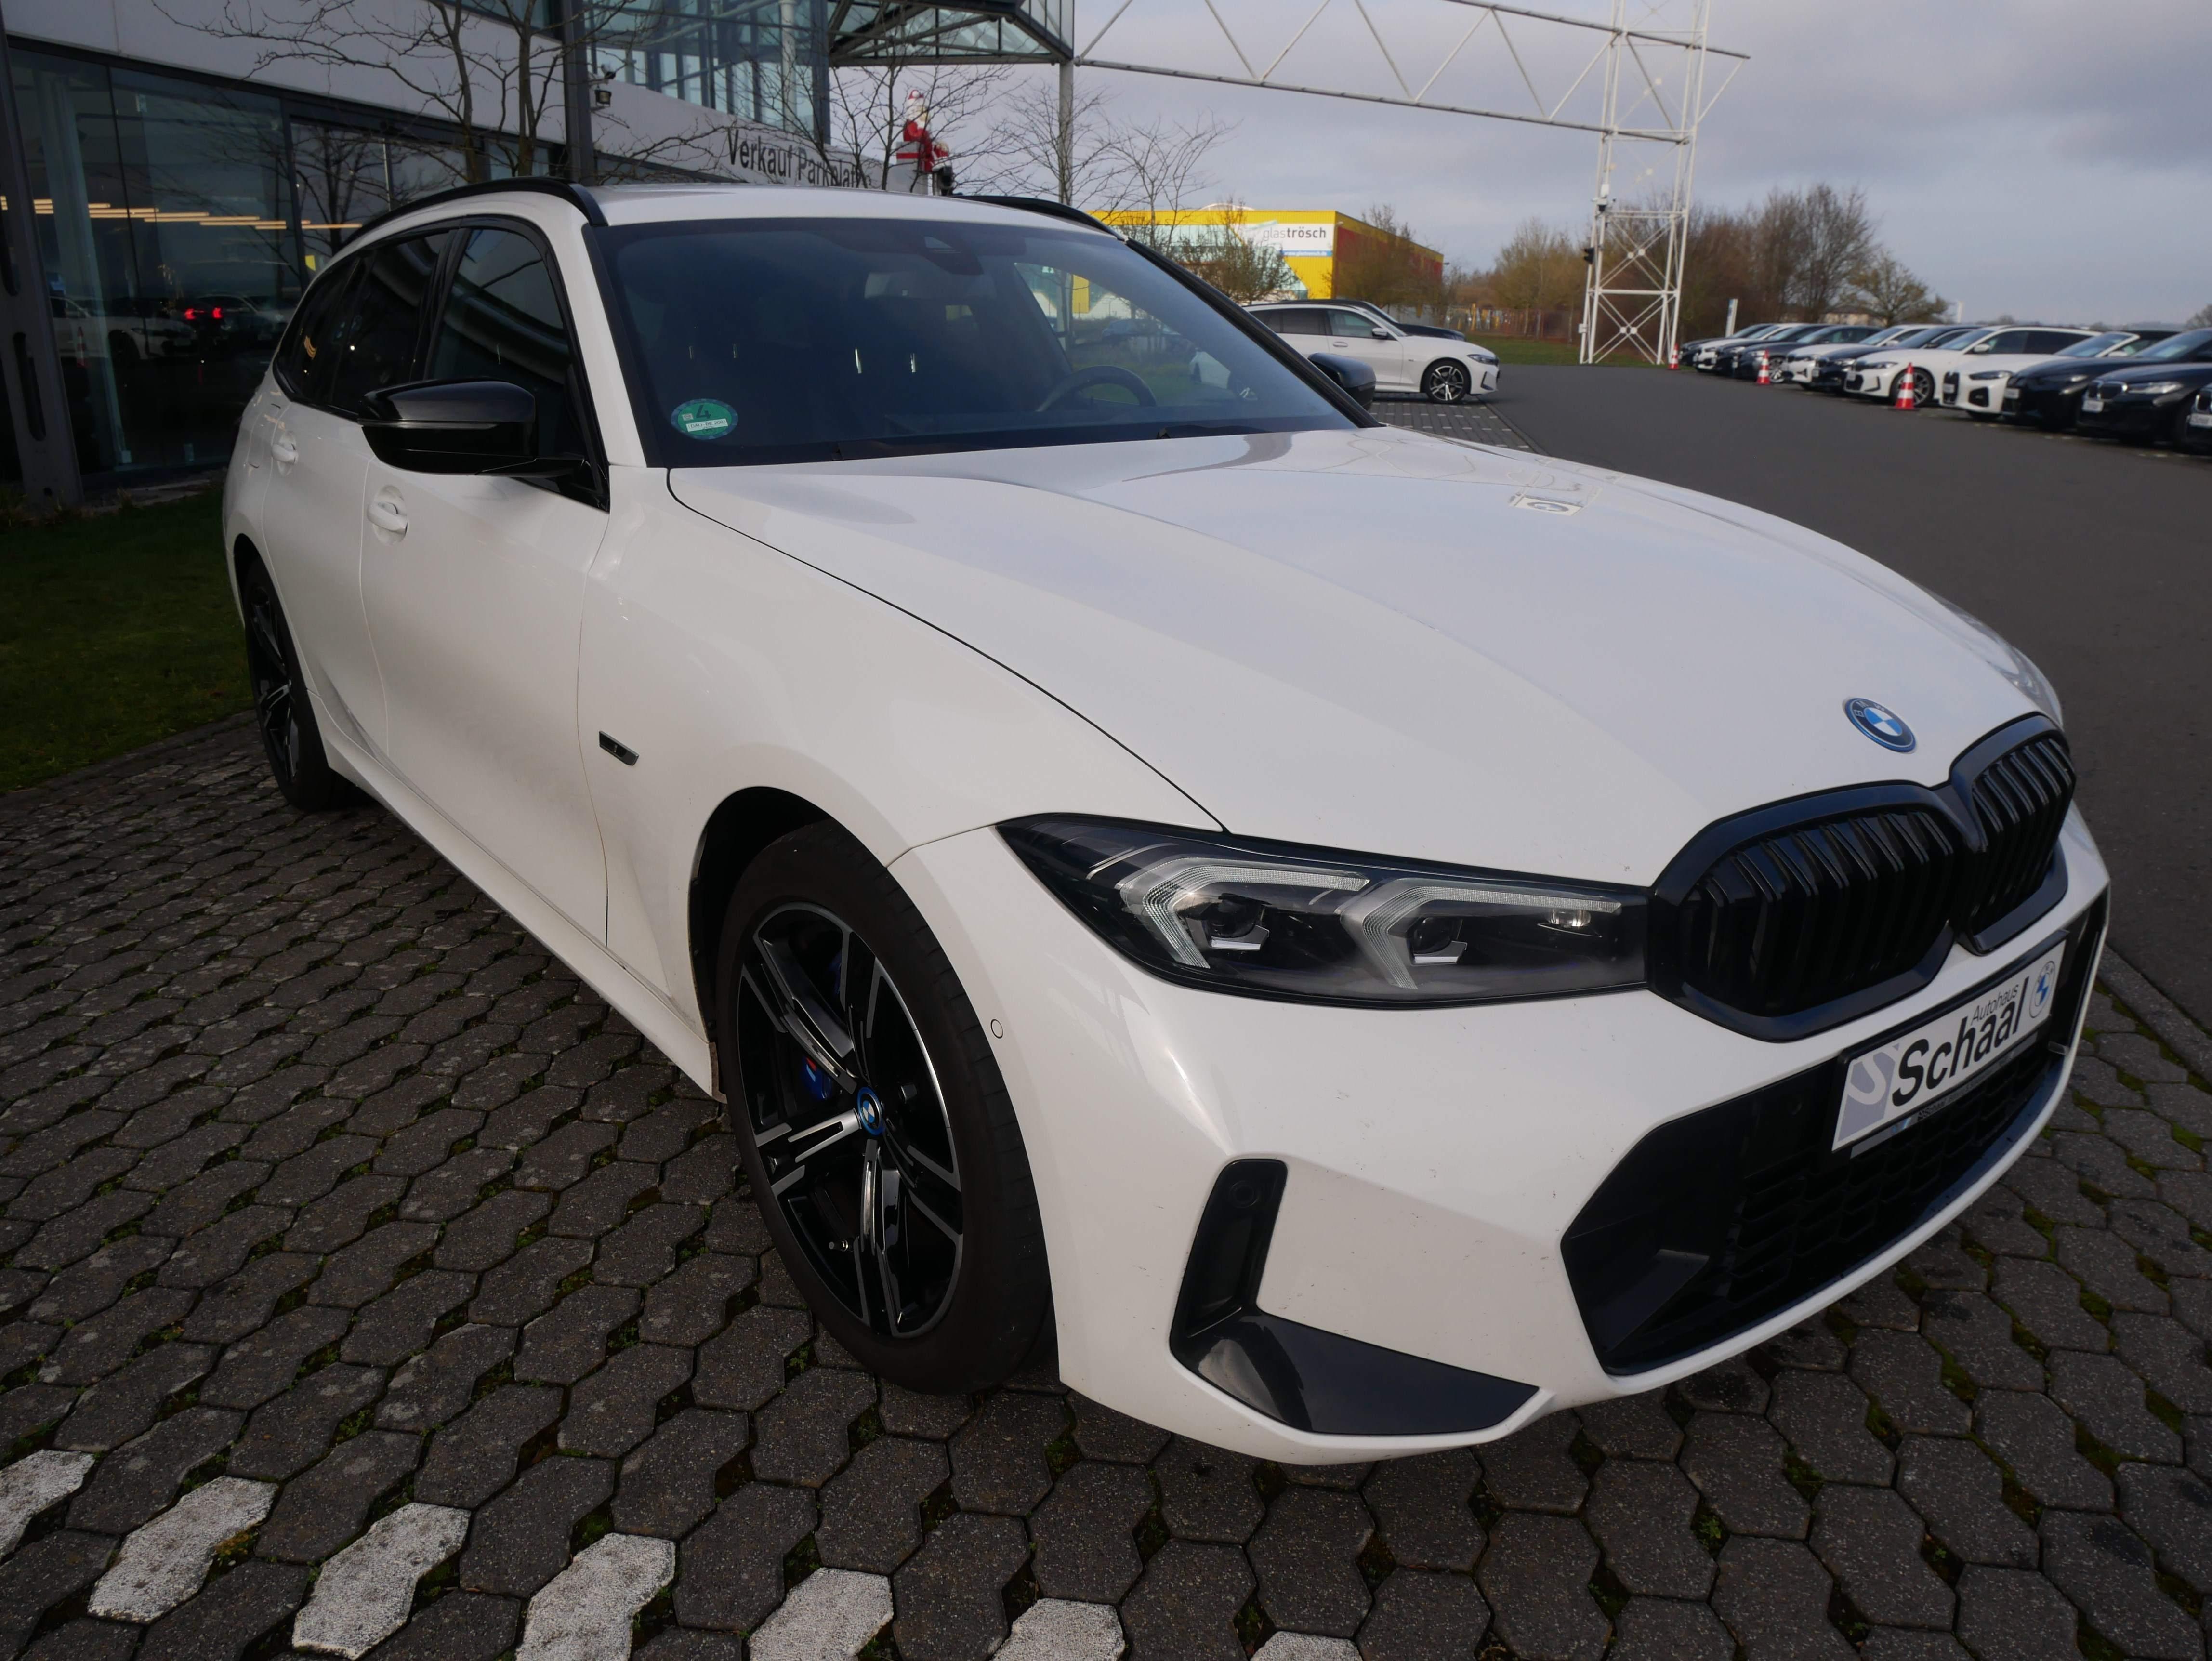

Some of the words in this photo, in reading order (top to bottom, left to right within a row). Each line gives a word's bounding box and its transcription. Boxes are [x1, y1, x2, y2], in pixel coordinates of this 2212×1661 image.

[727, 128, 792, 179] Verkauf
[1263, 226, 1326, 241] glaströsch
[697, 405, 711, 419] 4
[1971, 984, 2018, 1025] Autohaus
[1892, 976, 2029, 1107] Schaal
